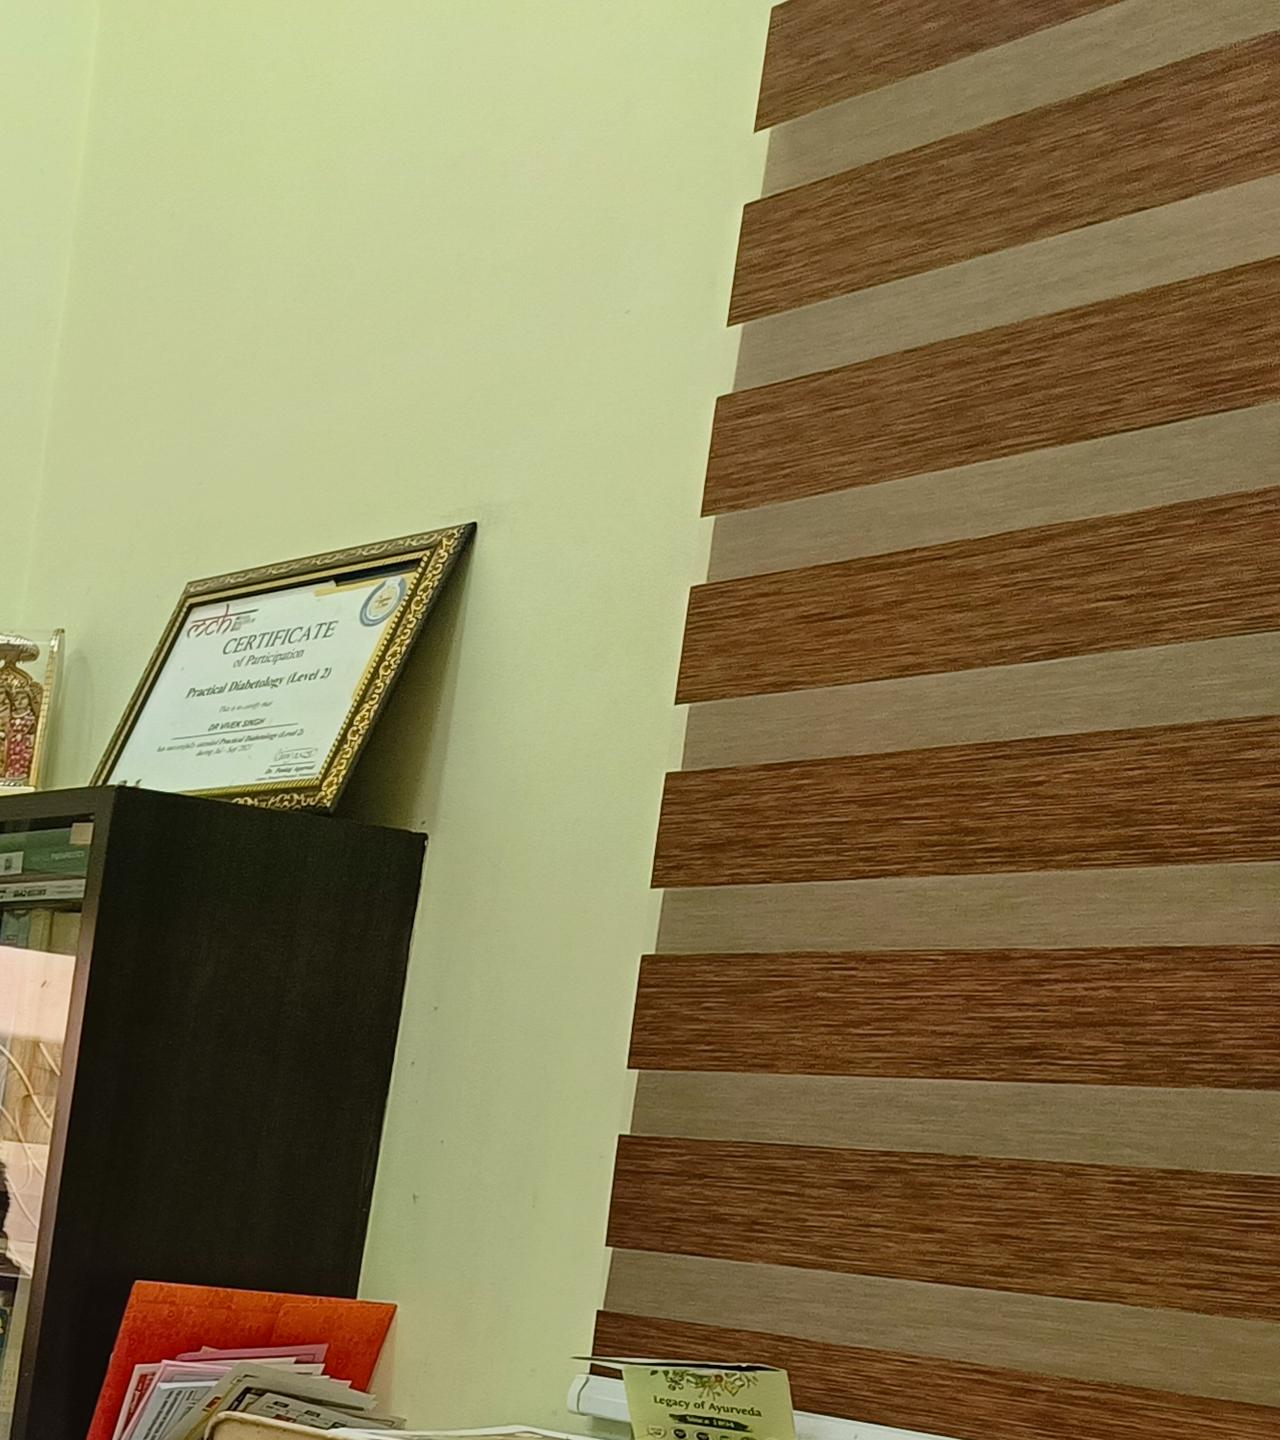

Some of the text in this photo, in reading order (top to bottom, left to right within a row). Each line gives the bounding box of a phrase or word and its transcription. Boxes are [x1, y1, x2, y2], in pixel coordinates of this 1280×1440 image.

[223, 620, 339, 655] CERTIFICATE
[233, 649, 305, 668] of Participation
[185, 667, 332, 698] Practical Diabetology (Level 2)
[652, 1395, 763, 1417] Legacy of Ayurveda
